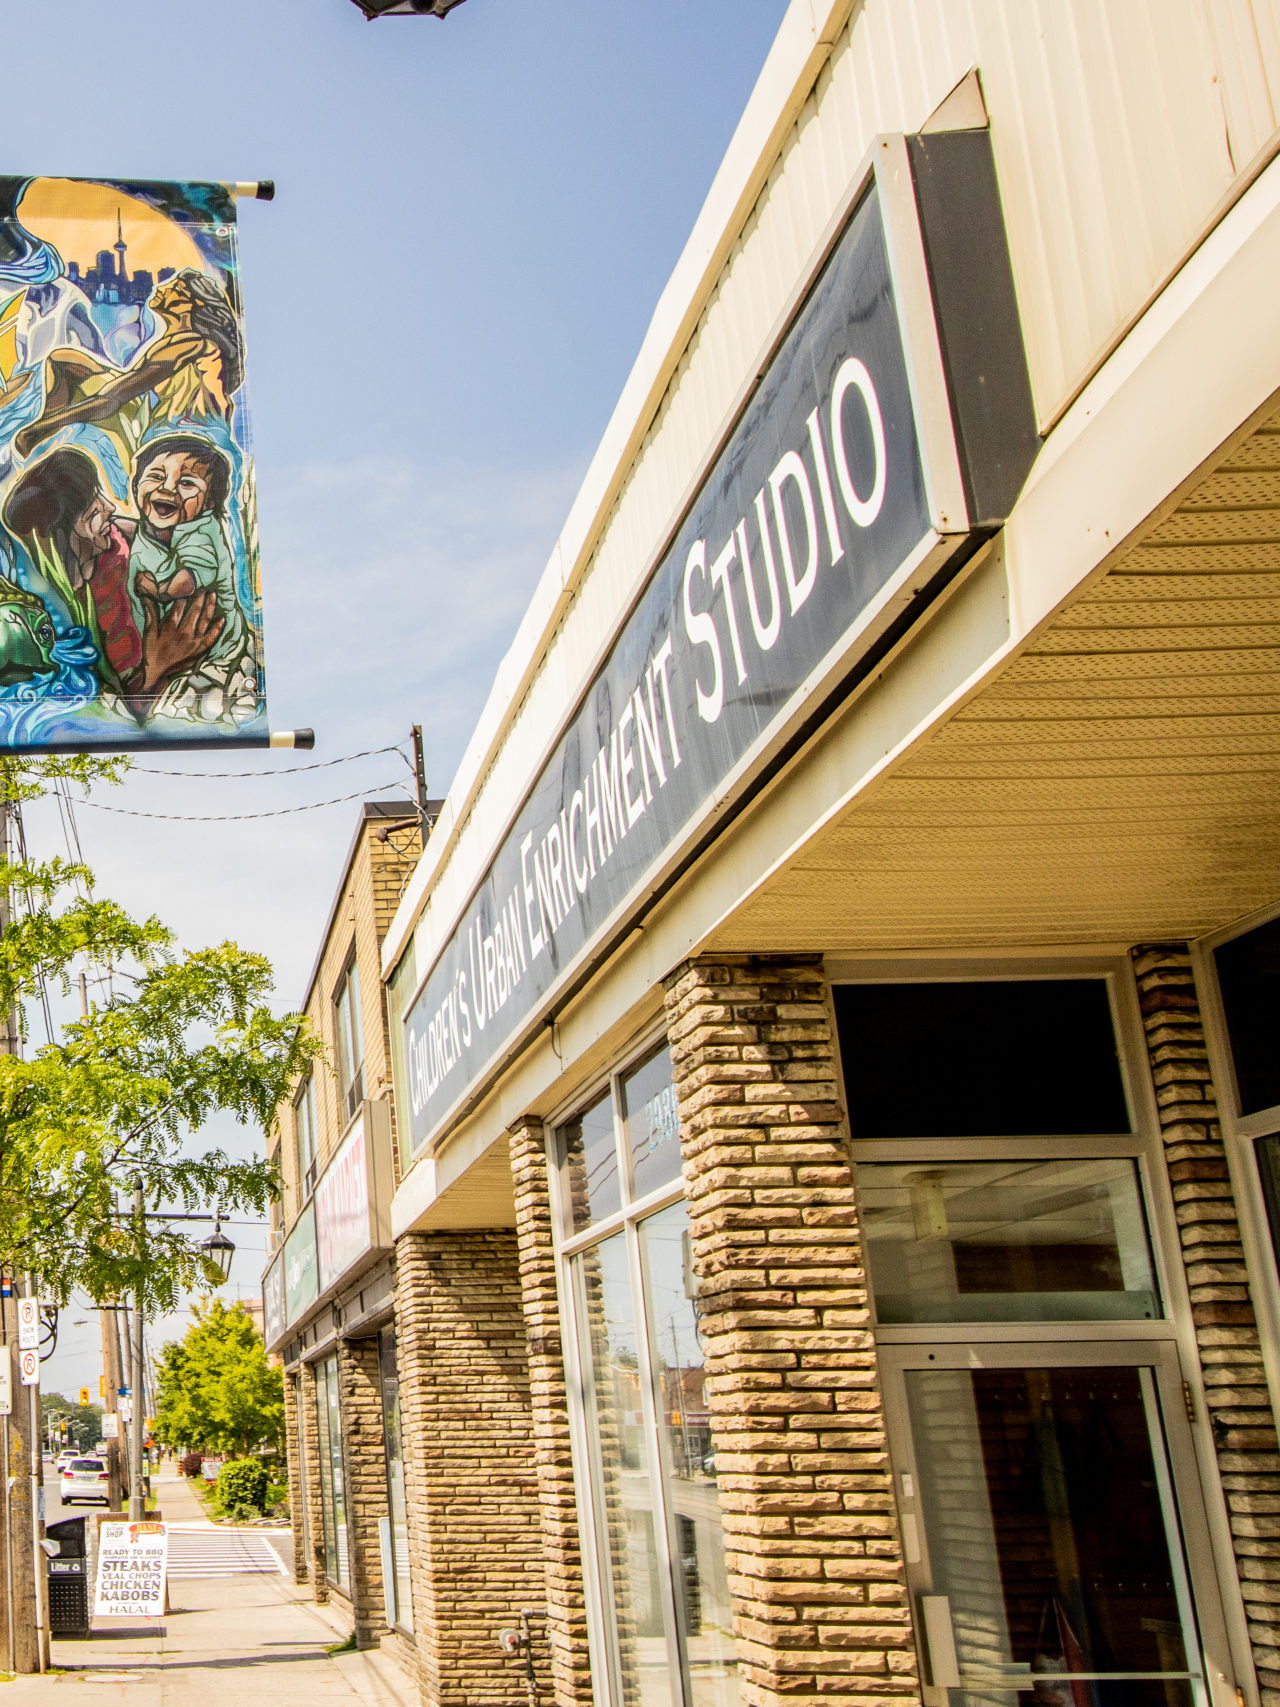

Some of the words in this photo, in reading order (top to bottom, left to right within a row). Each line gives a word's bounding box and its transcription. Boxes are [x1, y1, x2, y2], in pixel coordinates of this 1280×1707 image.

[469, 884, 527, 1030] URBAN
[521, 631, 682, 960] ENRICHMENT
[683, 357, 887, 723] STUDIO
[50, 1562, 70, 1571] Litter
[102, 1560, 162, 1572] STEAKS
[129, 1572, 161, 1580] CHOPS
[101, 1581, 161, 1590] CHICKEN
[100, 1591, 159, 1601] KABOBS
[109, 1606, 151, 1614] HALAL
